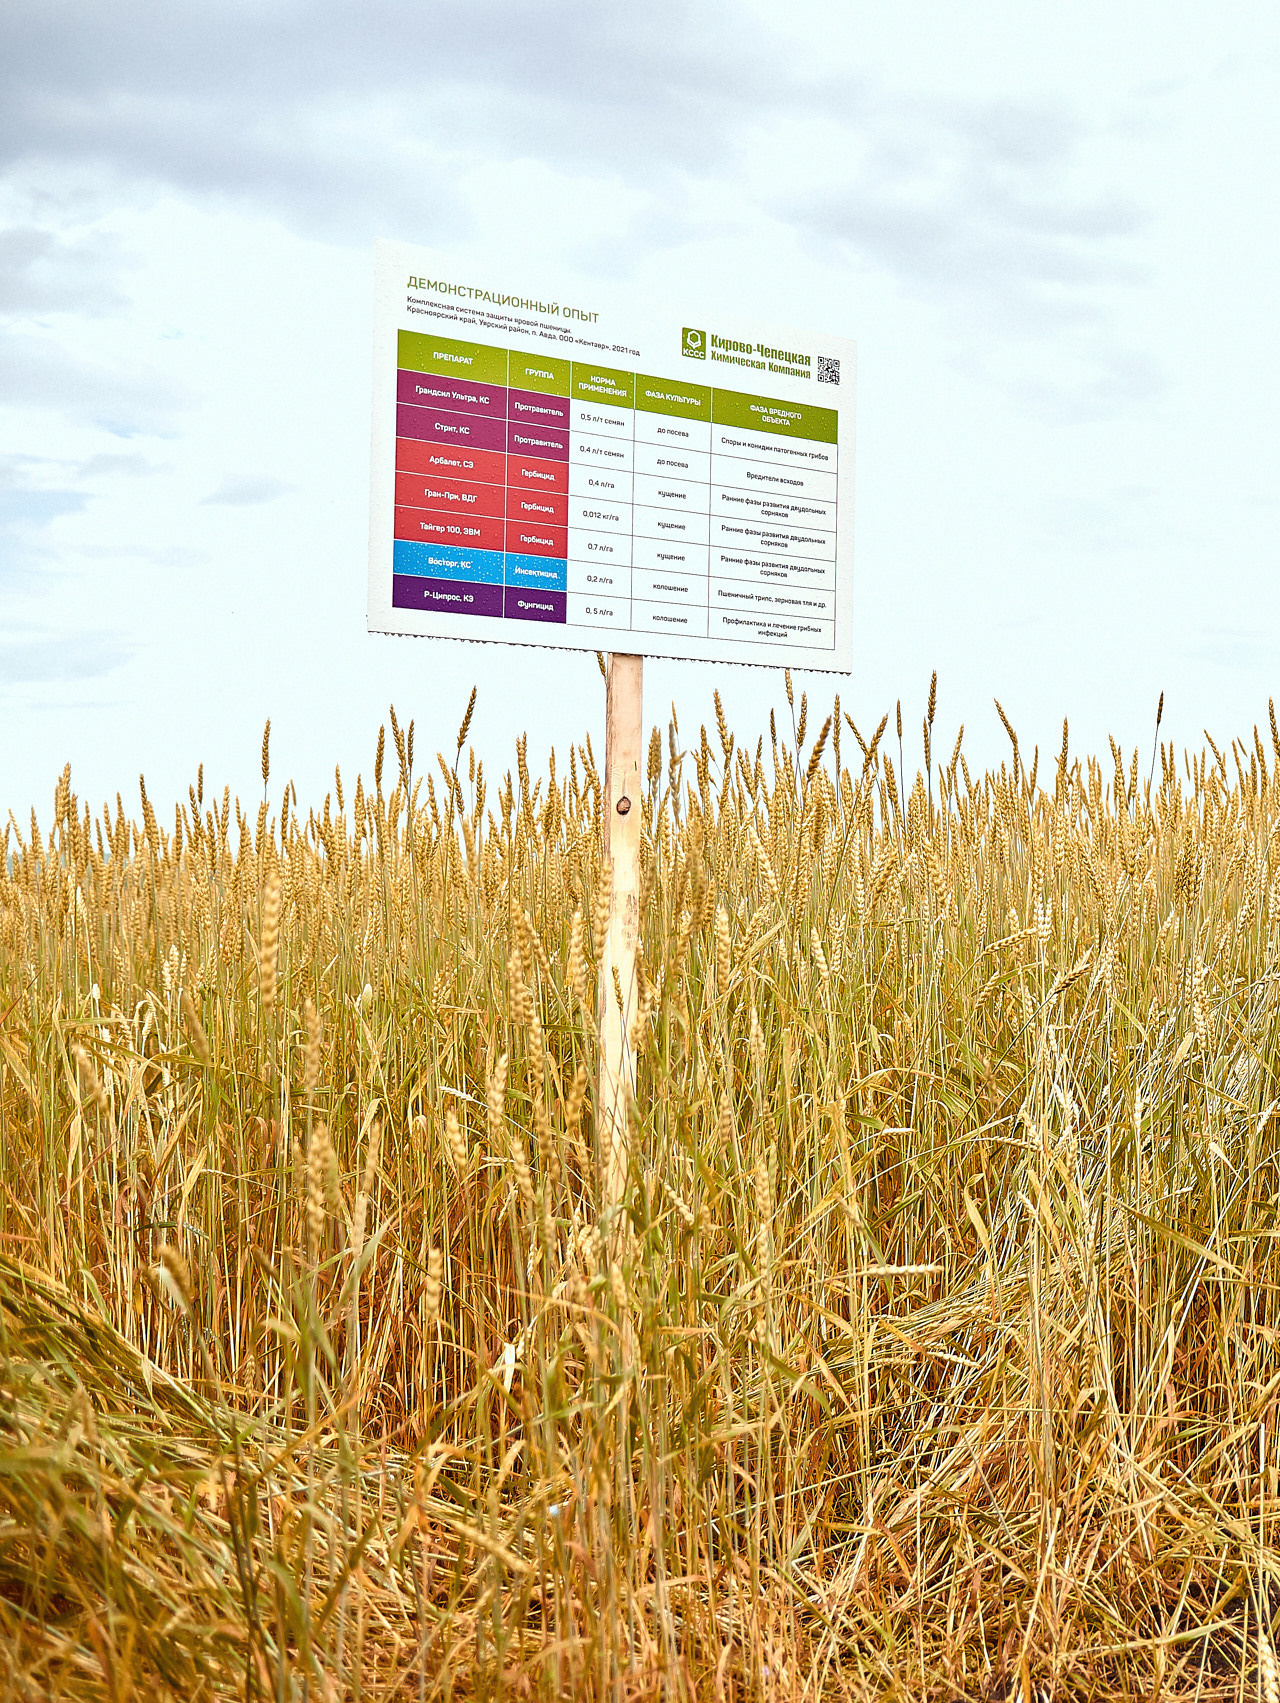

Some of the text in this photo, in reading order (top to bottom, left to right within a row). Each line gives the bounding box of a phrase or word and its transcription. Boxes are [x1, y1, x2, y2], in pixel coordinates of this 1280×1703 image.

[407, 276, 599, 323] ДЕМОНСТРАЦИОННЫЙ ОПЫТ
[407, 296, 454, 310] Комплексная
[456, 307, 484, 316] система
[486, 312, 516, 322] защиты
[514, 318, 538, 326] яровой
[407, 305, 458, 320] Красноярский
[479, 319, 507, 330] Уярский
[612, 345, 627, 353] 2021
[711, 334, 810, 366] Кирово-Чепецкая
[433, 352, 473, 365] ПРЕПАРАТ
[711, 351, 810, 379] Химическая Компания
[525, 368, 554, 379] ГРУППА
[590, 375, 616, 386] НОРМА
[416, 385, 450, 397] Грандсил
[480, 396, 489, 404] КС
[579, 382, 627, 397] ПРИМЕНЕНИЯ
[645, 390, 701, 406] ФАЗА КУЛЬТУРЫ
[515, 402, 563, 416] Протравитель
[750, 405, 802, 419] ФАЗА ВРЕДНОГО
[605, 418, 624, 426] семян
[762, 415, 790, 426] ОБЪЕКТА
[460, 426, 470, 434] КС
[667, 429, 689, 437] посева
[514, 435, 563, 449] Протравитель
[604, 450, 624, 458] семян
[722, 437, 741, 446] Споры
[748, 443, 772, 451] конидии
[774, 447, 807, 457] патогенных
[809, 453, 828, 461] грибов
[463, 460, 474, 468] СЭ
[666, 460, 688, 468] посева
[521, 469, 555, 481] Гербицид
[747, 472, 803, 486] Вредители всходов
[462, 494, 477, 502] ВДГ
[658, 490, 686, 499] кущение
[521, 502, 554, 513] Гербицид
[722, 494, 826, 515] Ранние фазы развития двудольных
[602, 513, 619, 521] кг/га
[761, 510, 788, 518] сорняков
[420, 522, 445, 534] Тайгер
[463, 527, 480, 536] ЭВМ
[658, 522, 686, 530] кущение
[722, 525, 743, 533] Ранние
[790, 536, 825, 544] двудольных
[520, 535, 553, 546] Гербицид
[761, 540, 788, 548] сорняков
[461, 560, 471, 568] КС
[721, 556, 743, 564] Ранние
[790, 566, 825, 574] двудольных
[515, 567, 558, 579] Инсектицид
[653, 584, 688, 592] колошение
[718, 590, 754, 599] Пшеничный
[518, 600, 554, 611] Фунгицид
[653, 615, 687, 623] колошение
[723, 617, 766, 627] Профилактика
[798, 625, 821, 633] грибных
